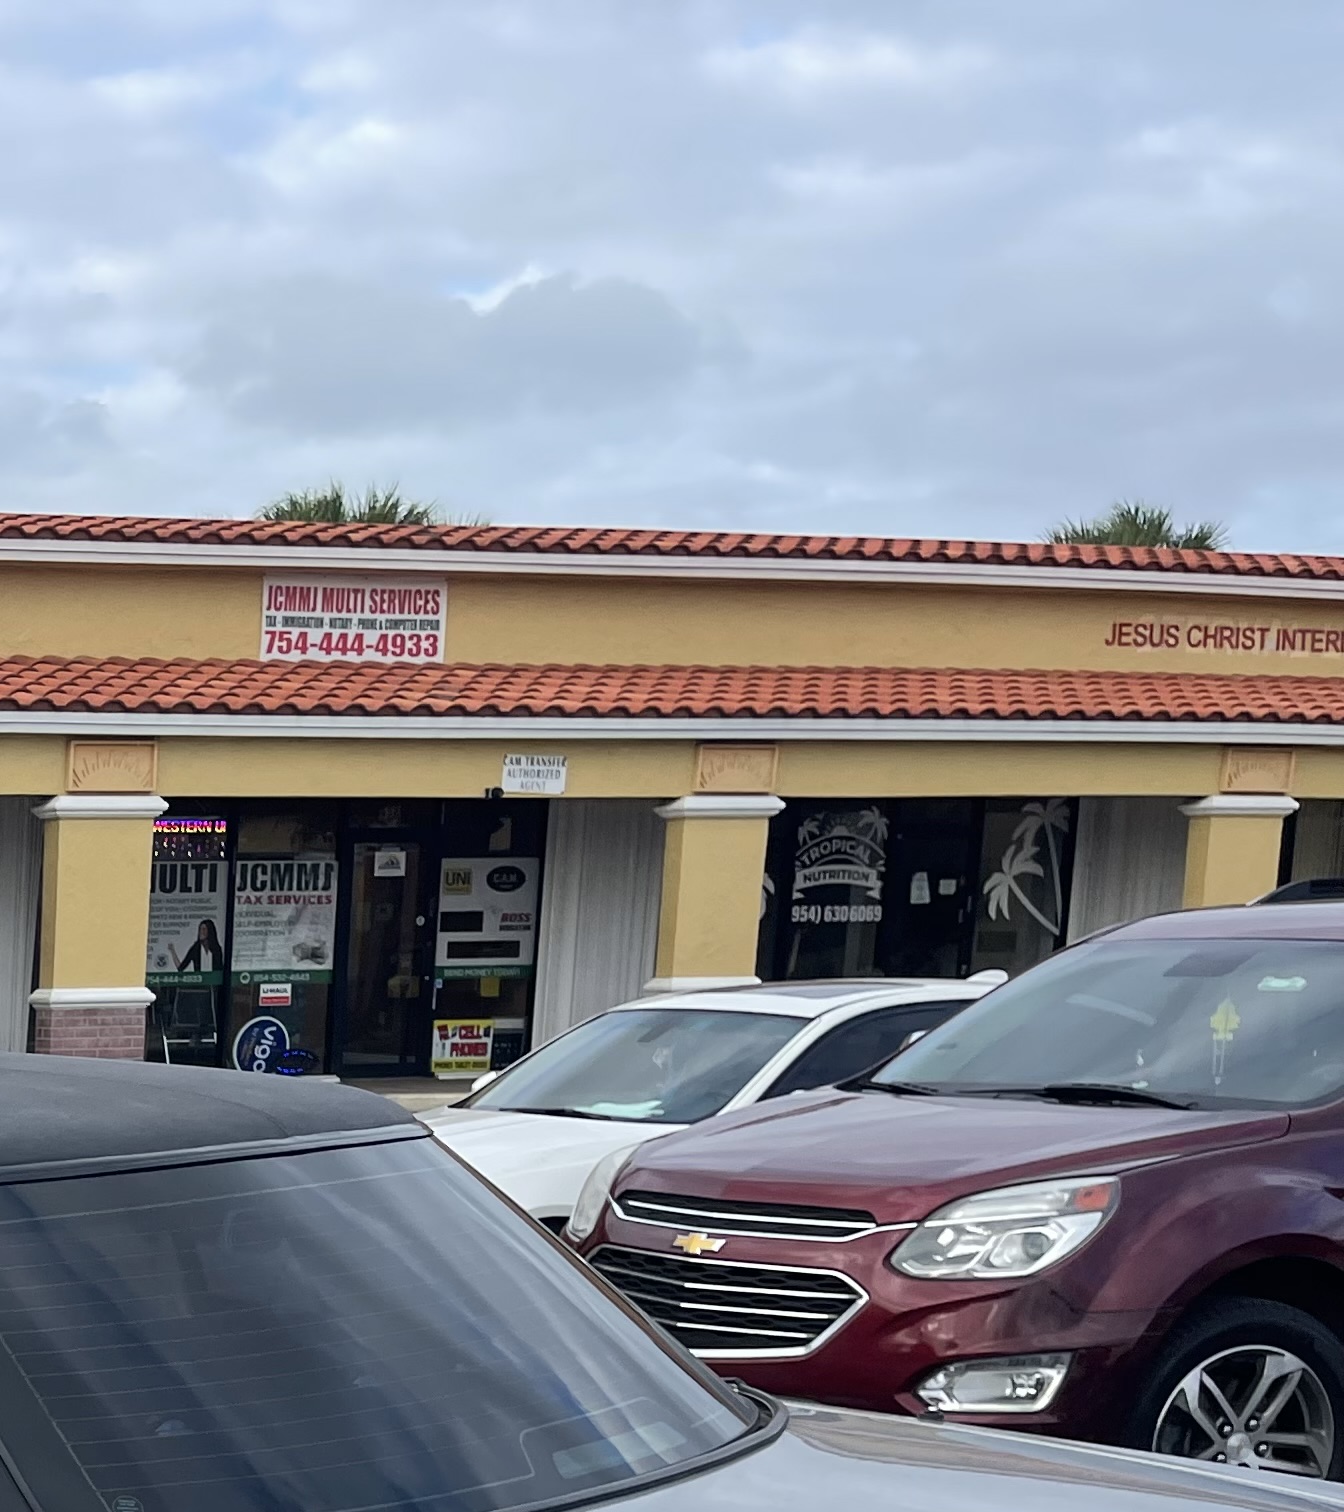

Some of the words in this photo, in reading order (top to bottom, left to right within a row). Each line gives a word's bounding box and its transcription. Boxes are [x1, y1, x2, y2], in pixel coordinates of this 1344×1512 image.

[265, 585, 318, 612] JCMMJ
[321, 587, 366, 615] MULTI
[369, 588, 441, 616] SERVICES
[264, 630, 439, 658] 754-444-4933
[1104, 622, 1180, 649] JESUS
[1186, 625, 1271, 651] CHRIST
[1275, 628, 1344, 653] INTER
[800, 838, 873, 866] TROPICAL
[236, 862, 335, 893] JCMMJ
[445, 871, 471, 887] UNI
[803, 869, 871, 884] NUTRITION
[236, 895, 264, 906] TAX
[267, 894, 333, 906] SERVICES
[148, 974, 203, 984] 54-444-4933
